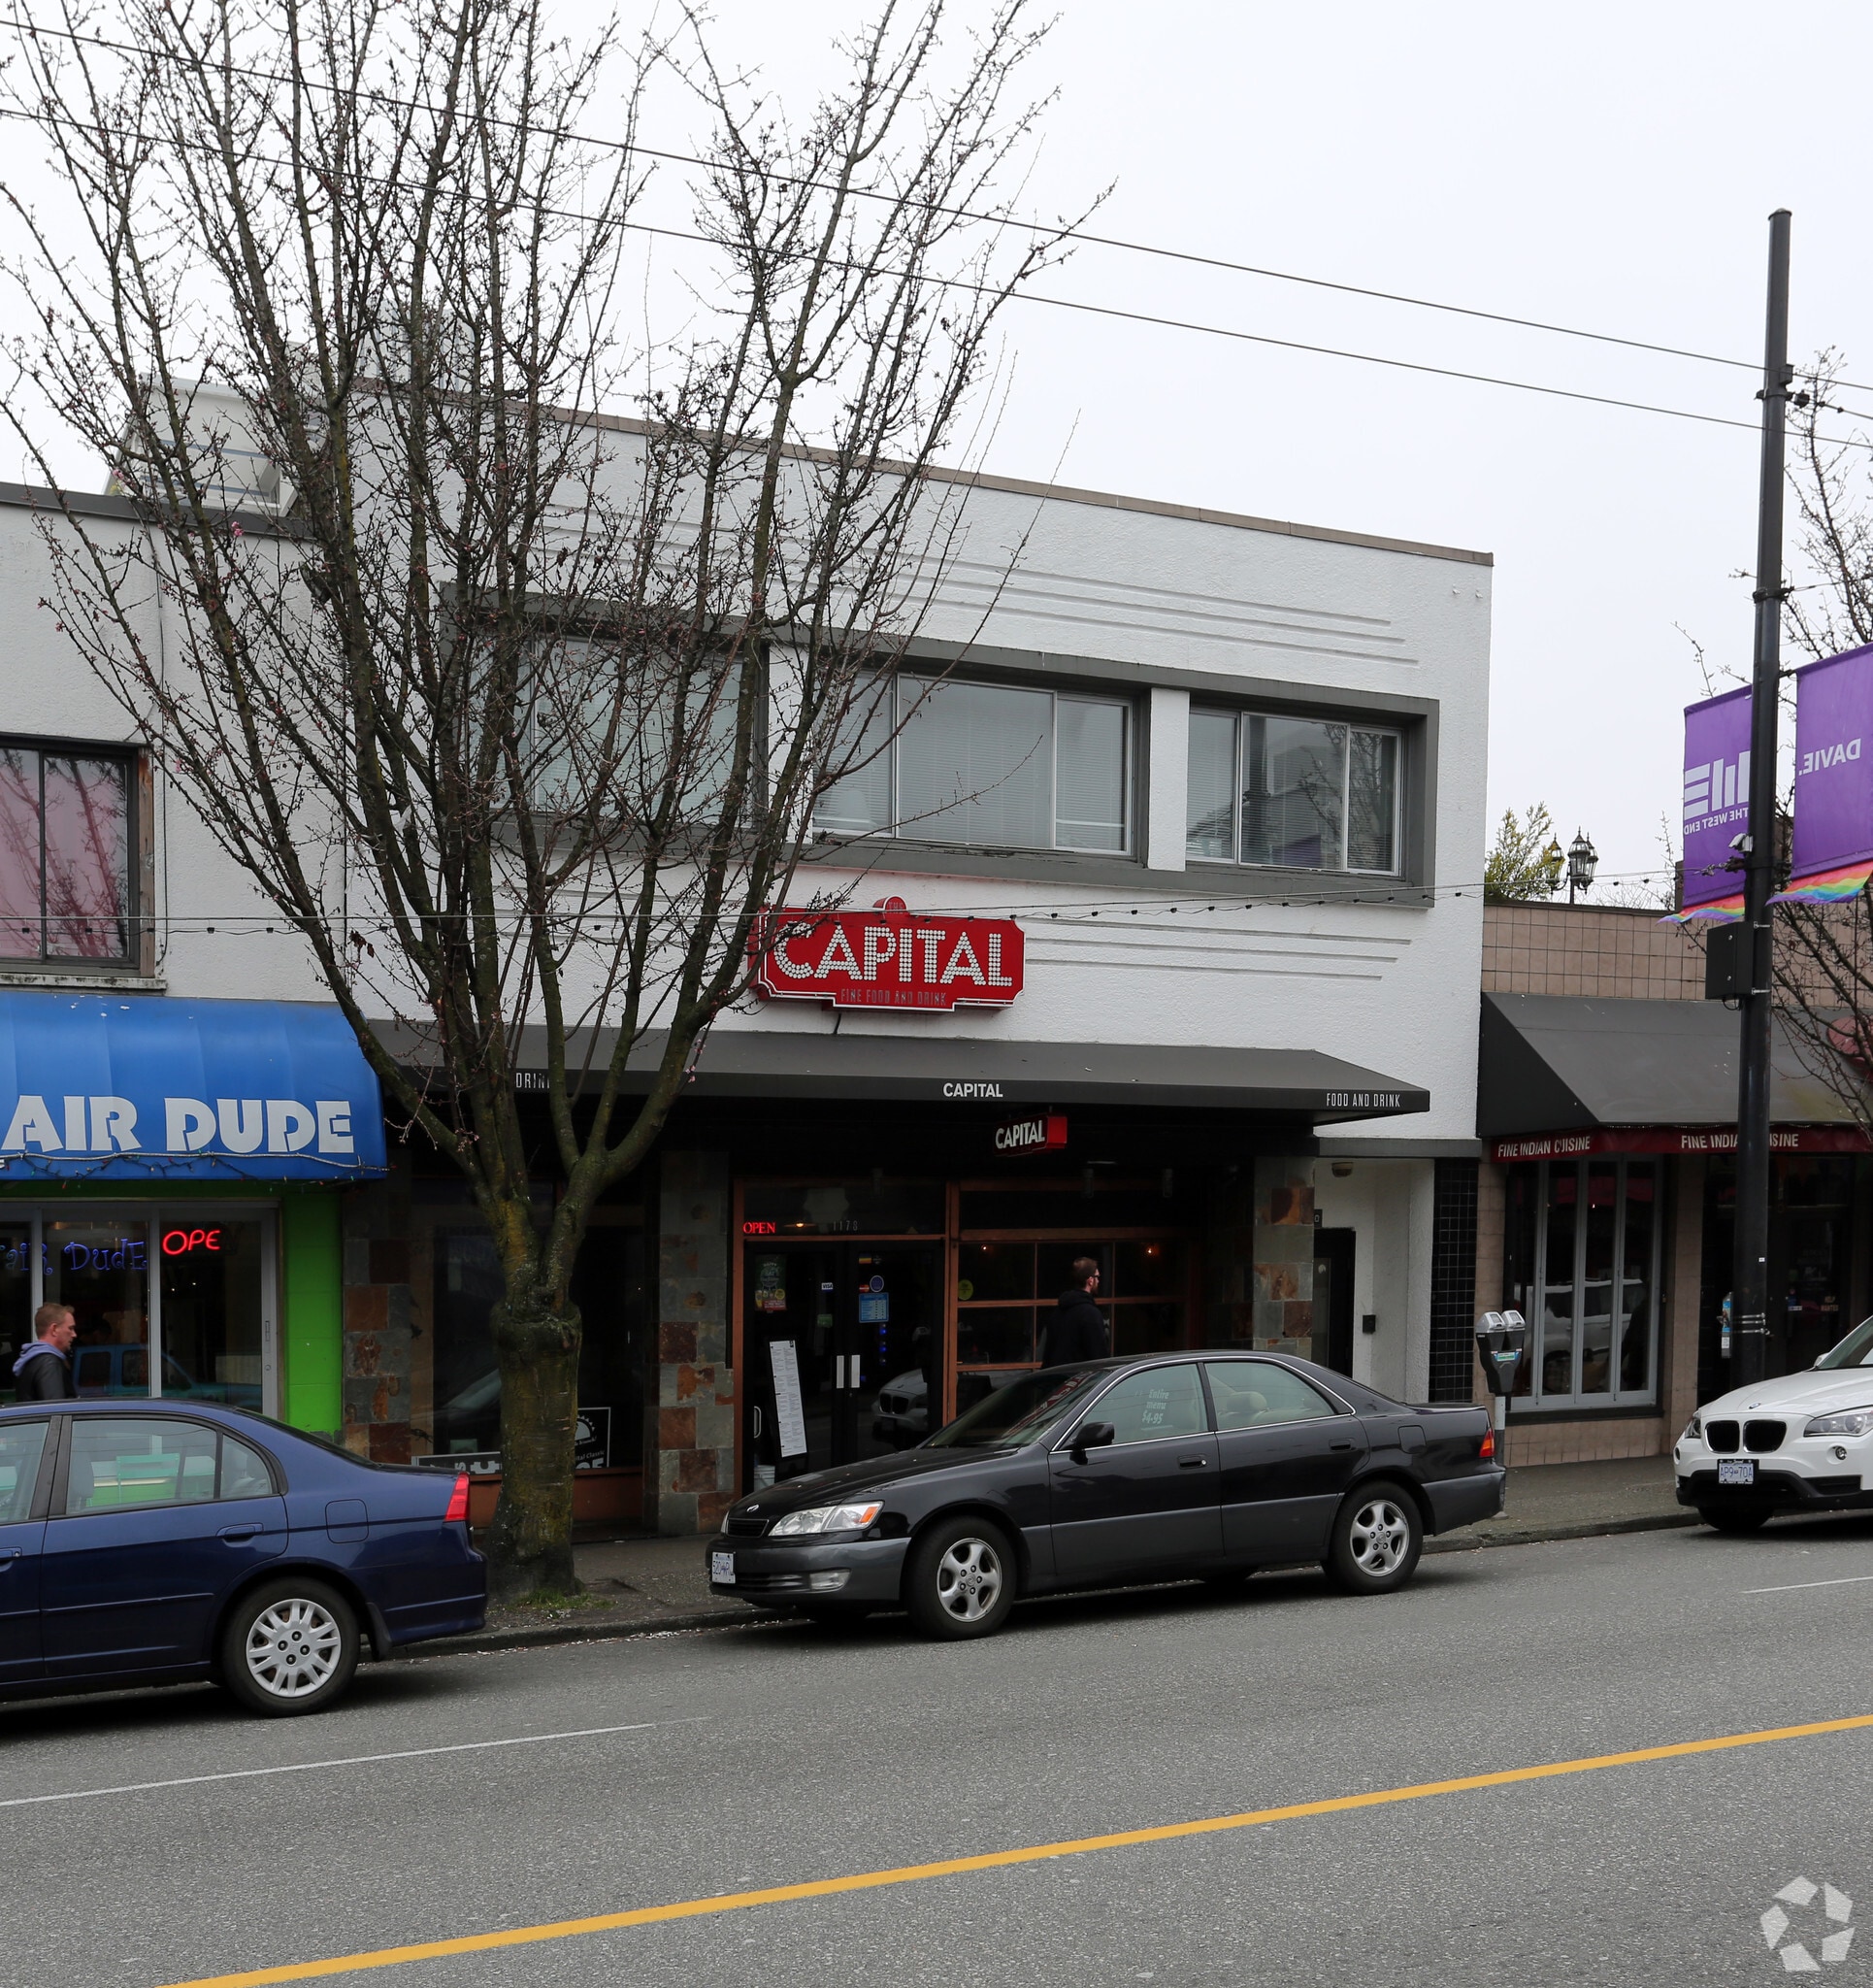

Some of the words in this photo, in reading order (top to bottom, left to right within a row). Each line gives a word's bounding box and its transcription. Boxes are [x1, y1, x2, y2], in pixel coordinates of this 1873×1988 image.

[773, 921, 1013, 987] CAPITAL
[840, 988, 862, 1003] FINE
[866, 988, 891, 1004] FOOD
[894, 990, 913, 1005] AND
[917, 991, 947, 1007] DRINK
[943, 1082, 1003, 1098] CAPITAL
[1326, 1092, 1349, 1107] FOOD
[1352, 1093, 1369, 1108] AND
[1373, 1093, 1400, 1108] DRINK
[1, 1095, 142, 1152] AIR
[165, 1097, 354, 1153] DUDE
[995, 1119, 1046, 1149] CAPITAL
[1681, 1135, 1708, 1149] FINE
[1710, 1134, 1739, 1148] INDIA
[1769, 1133, 1799, 1147] ISINE
[1497, 1143, 1518, 1158] FINE
[1520, 1140, 1552, 1156] INDIAN
[1554, 1136, 1591, 1153] CUISINE
[742, 1221, 776, 1234] OPEN
[833, 1219, 858, 1232] 1178
